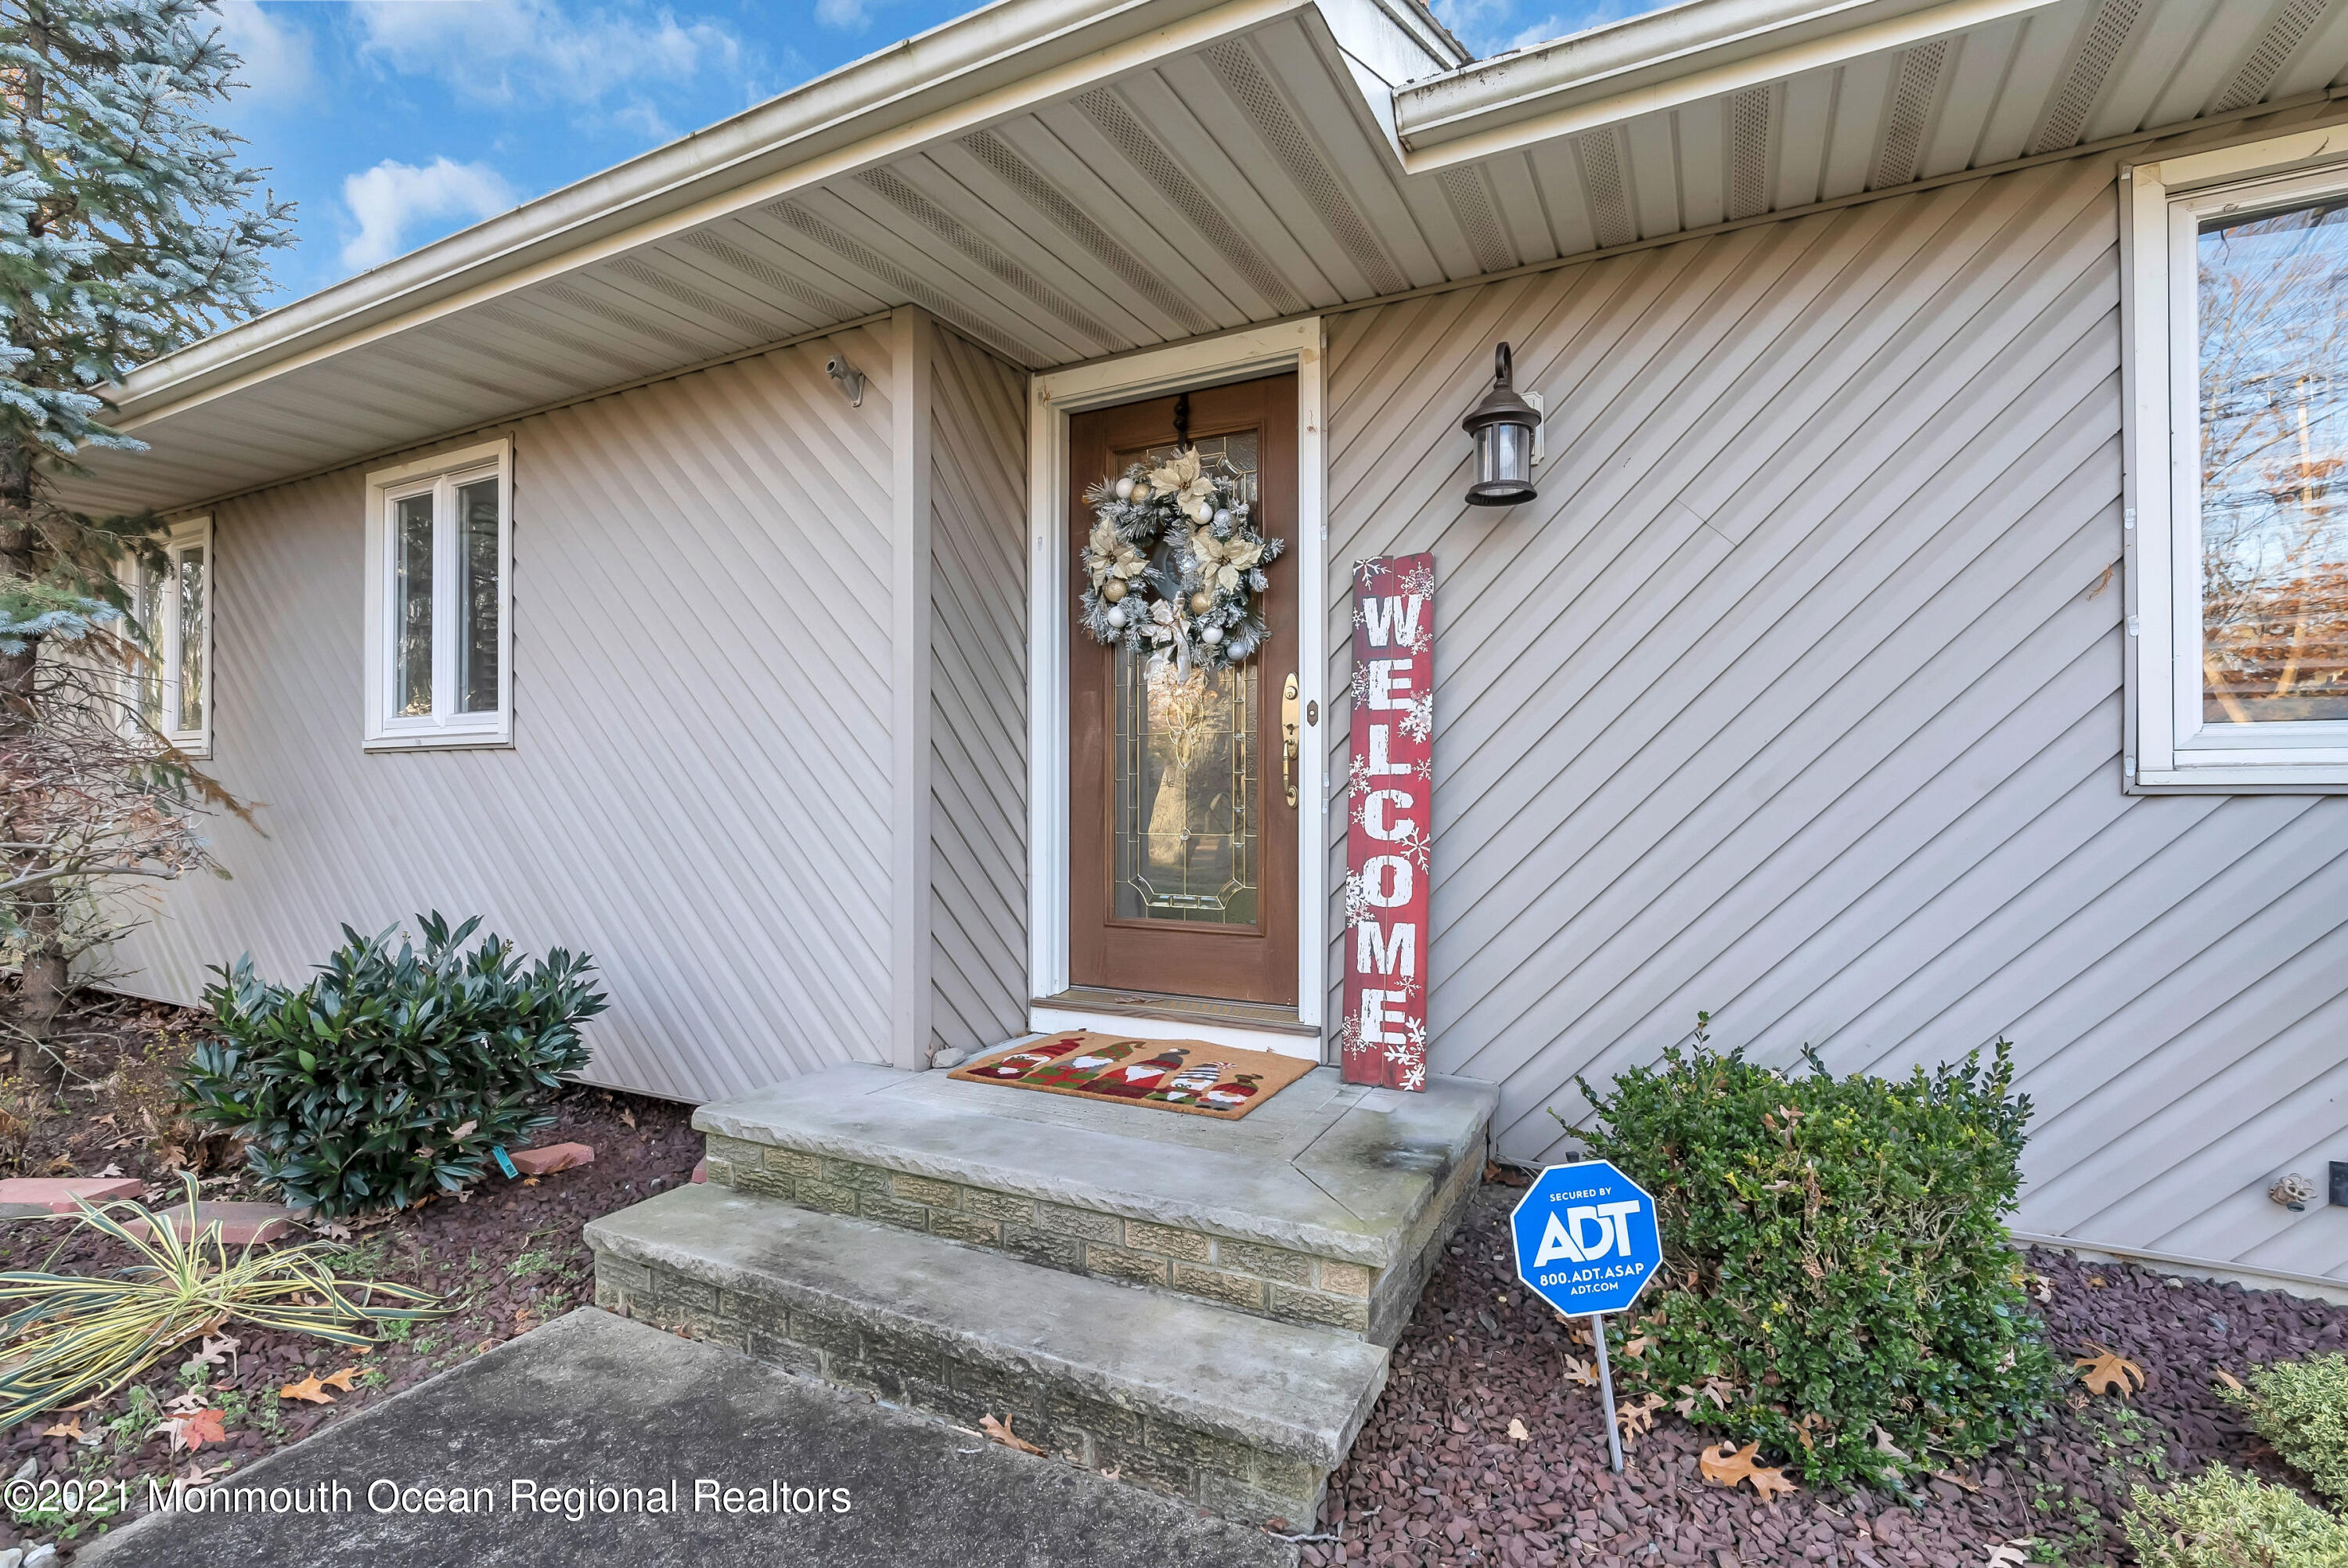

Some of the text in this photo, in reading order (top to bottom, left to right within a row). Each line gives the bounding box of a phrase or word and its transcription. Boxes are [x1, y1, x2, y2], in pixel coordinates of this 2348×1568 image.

[1357, 594, 1423, 1045] WELCOME
[1550, 1187, 1612, 1202] SECURED BY
[1533, 1199, 1640, 1268] ADT
[1540, 1263, 1644, 1286] 800.ADT.ASAP
[1570, 1282, 1619, 1295] ADT.COM
